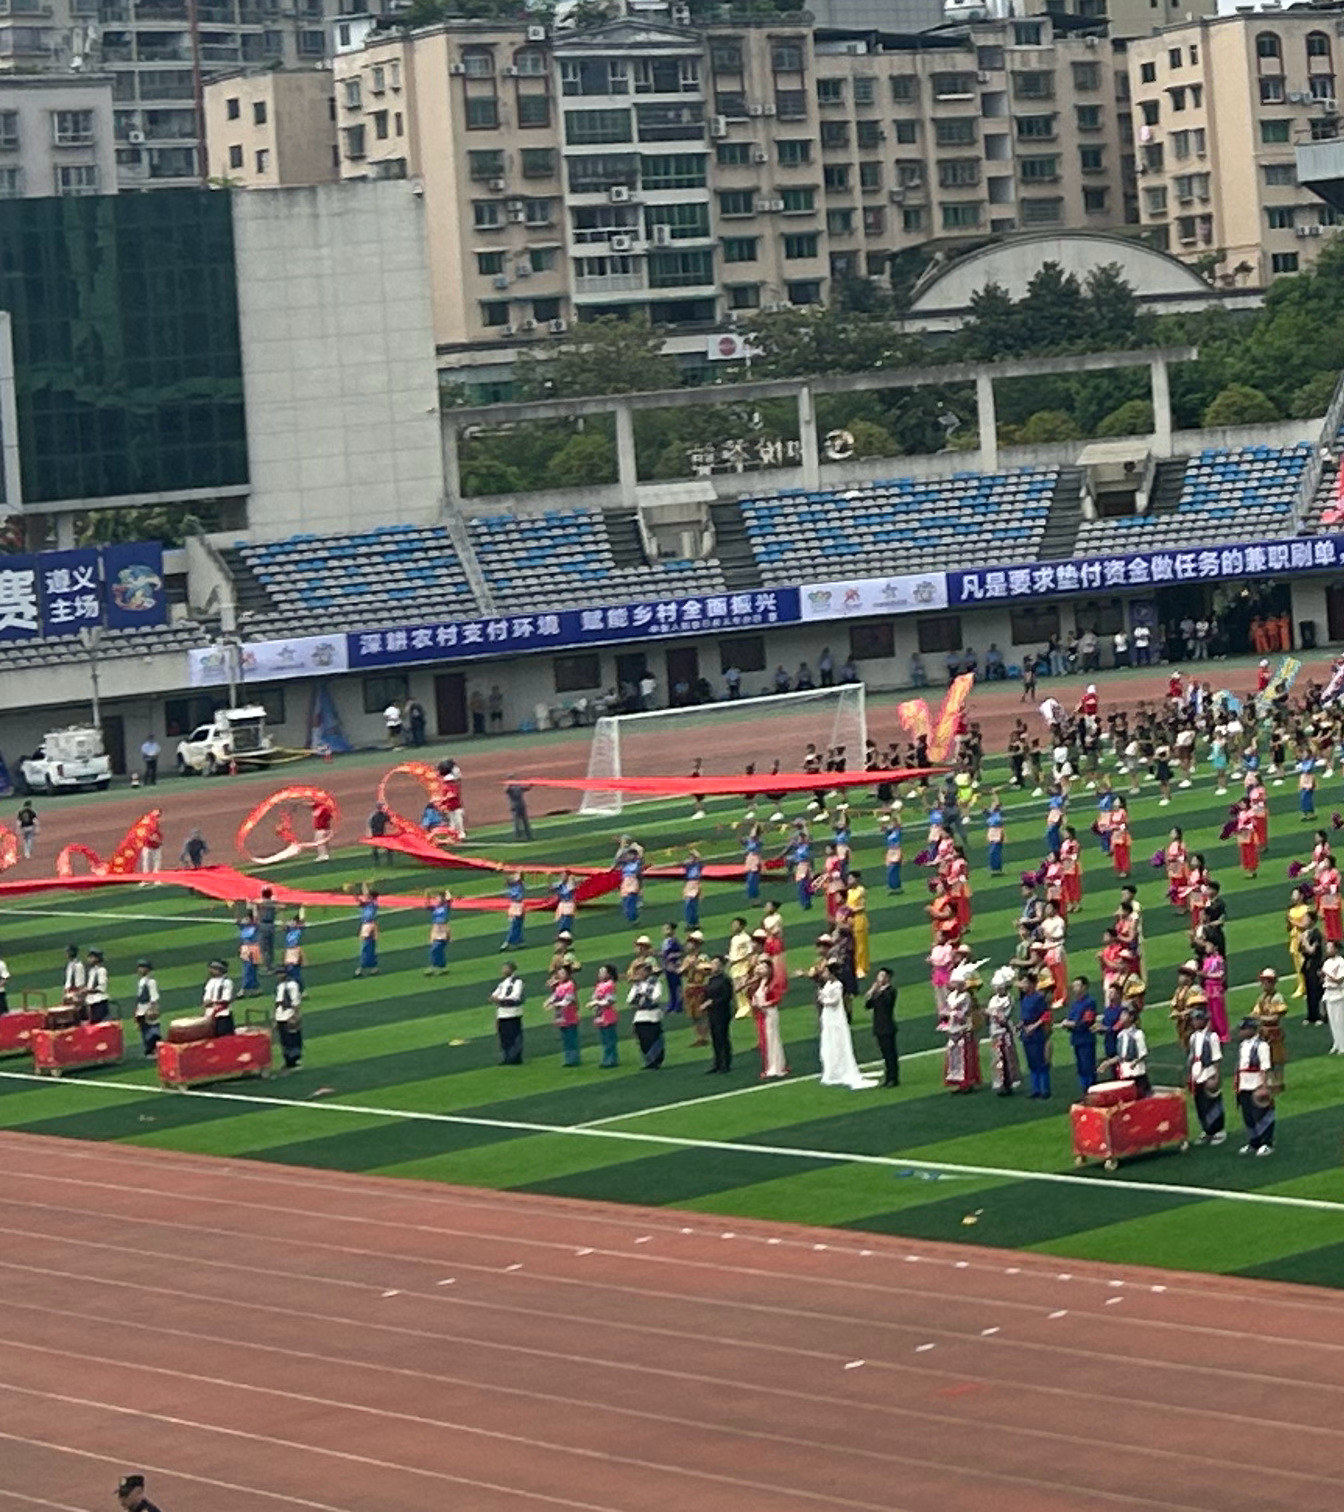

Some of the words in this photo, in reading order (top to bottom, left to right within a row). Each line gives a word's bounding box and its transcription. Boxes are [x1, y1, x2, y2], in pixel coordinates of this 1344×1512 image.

[44, 565, 97, 594] 遵义
[49, 594, 99, 623] 主场
[359, 614, 561, 655] 深耕农村支付环境
[581, 592, 778, 631] 赋能乡村全面振兴
